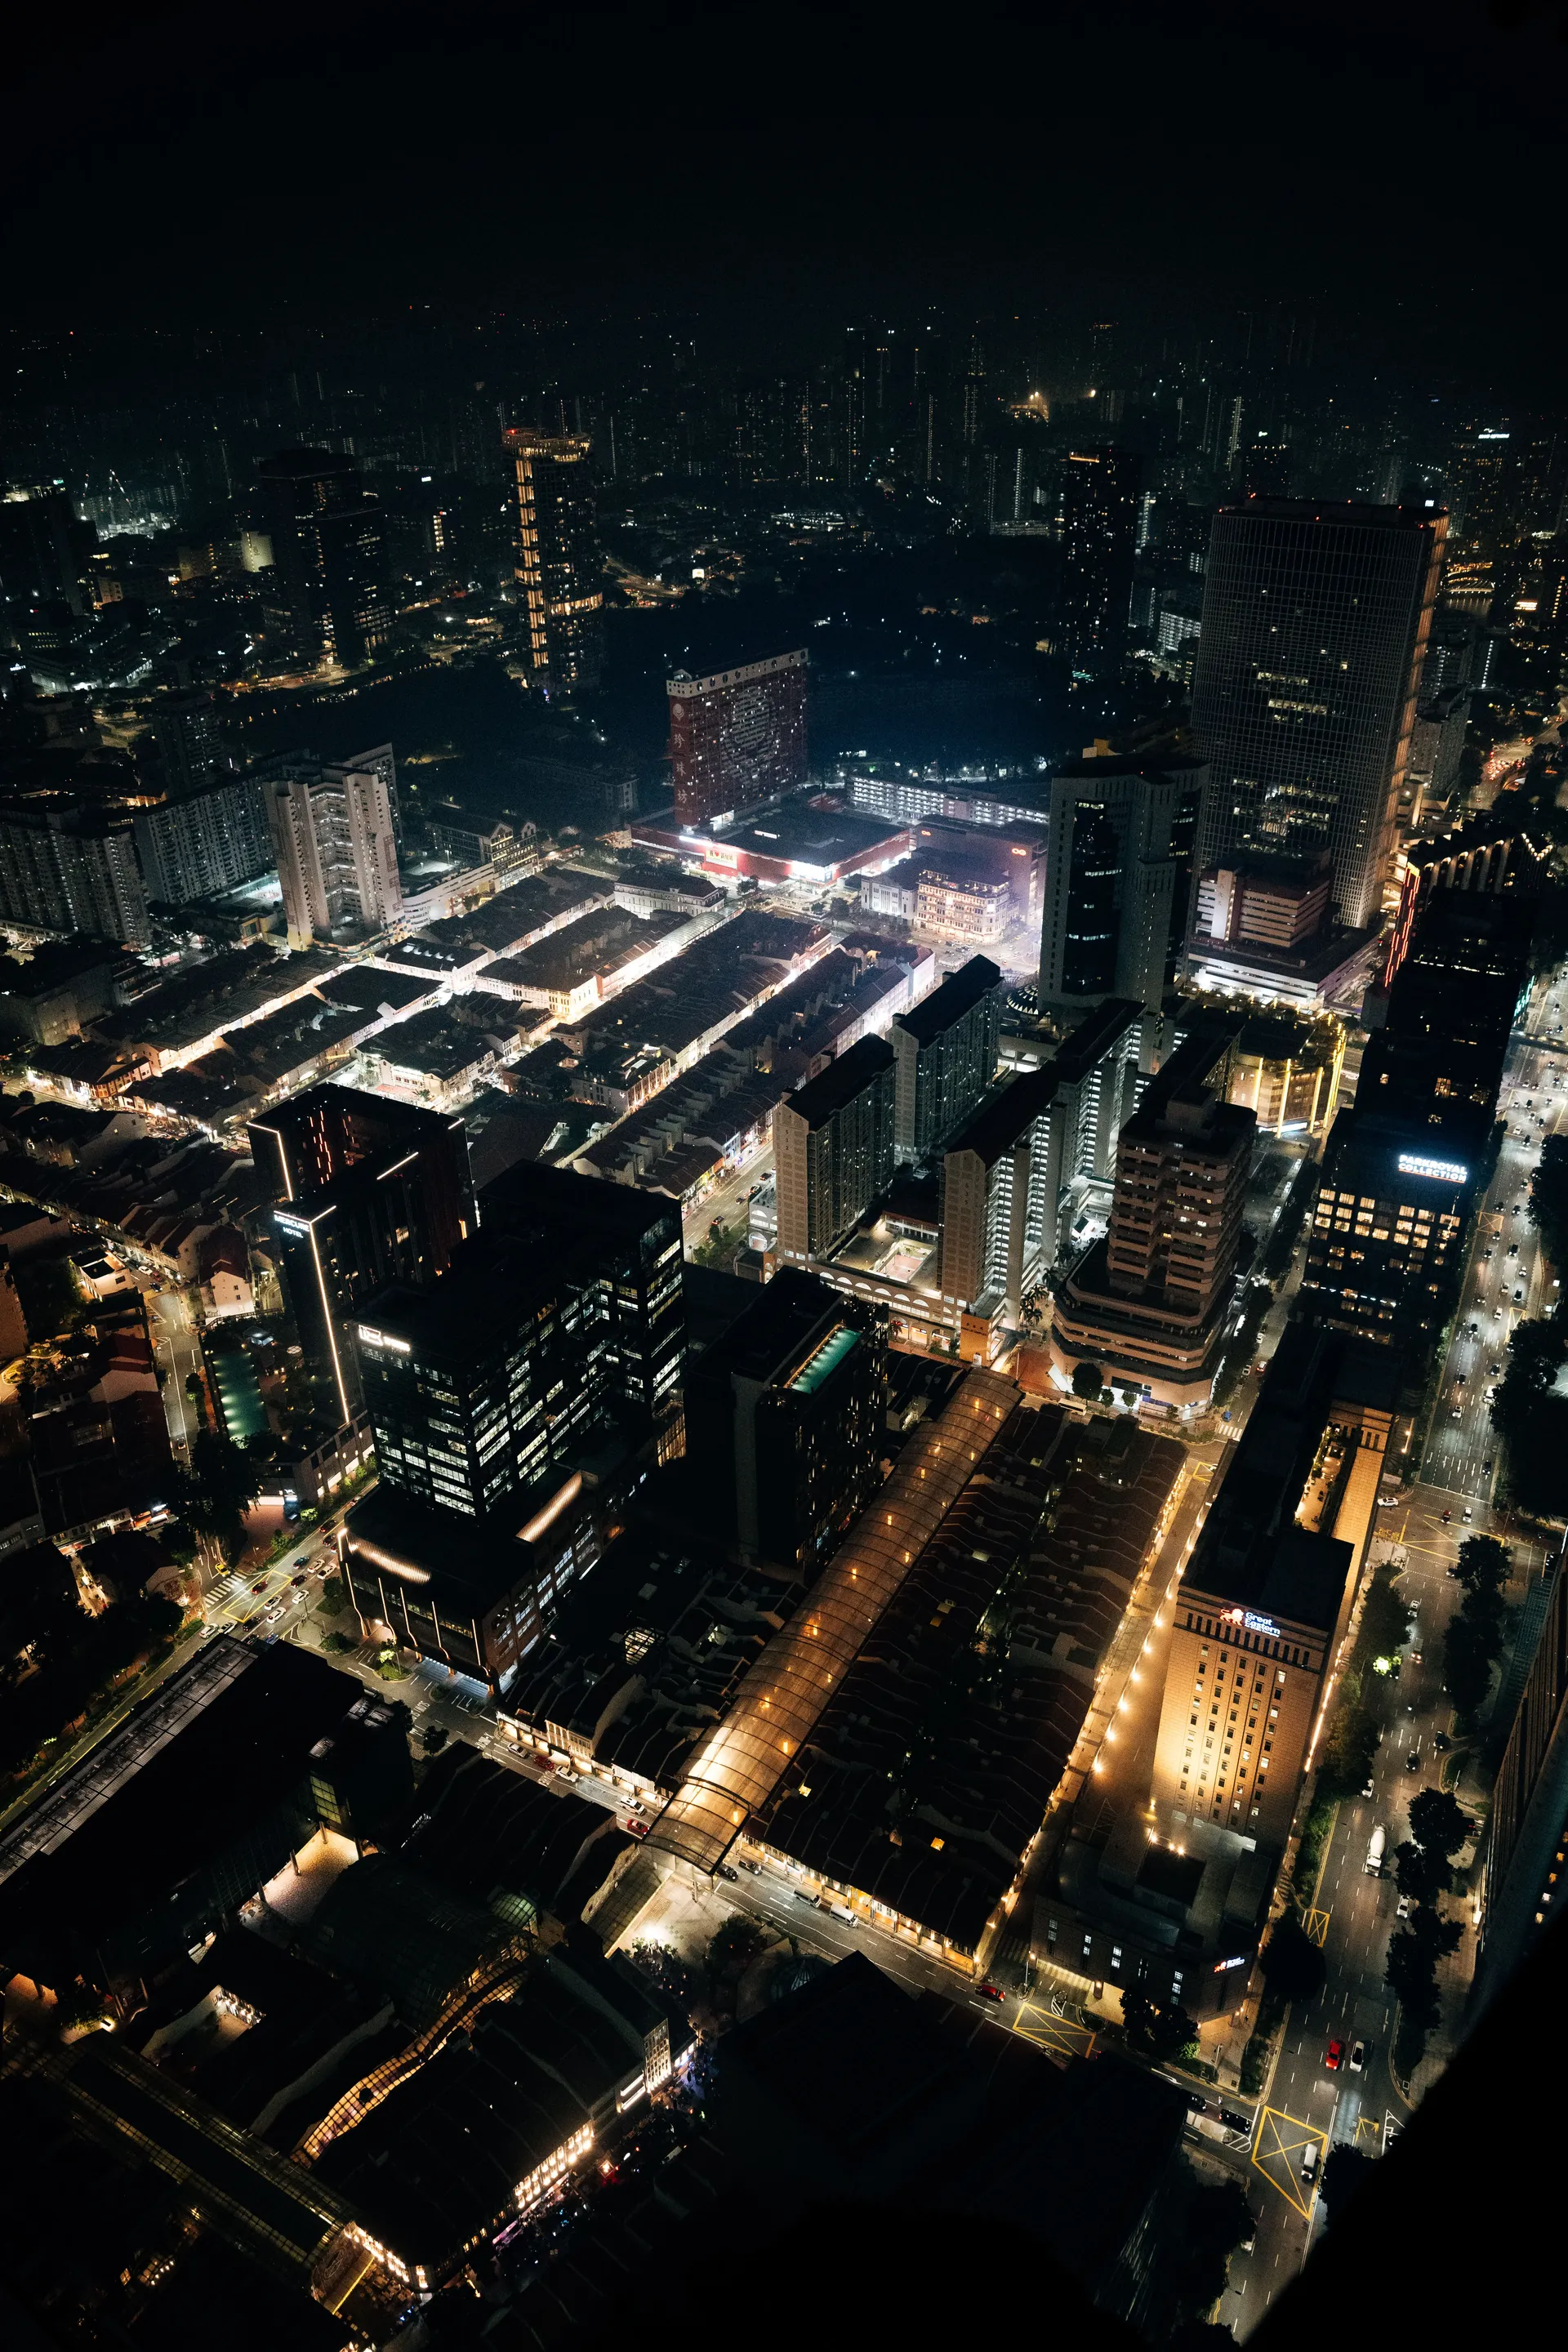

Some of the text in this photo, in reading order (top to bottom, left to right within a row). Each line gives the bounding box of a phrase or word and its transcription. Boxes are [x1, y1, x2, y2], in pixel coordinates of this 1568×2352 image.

[674, 733, 688, 804] 珍珠坊
[1398, 1162, 1467, 1181] COLLECTION
[1399, 1155, 1468, 1174] PARKROYAL
[274, 1214, 310, 1232] MERCURE
[283, 1227, 304, 1238] HOTEL
[1245, 1612, 1272, 1626] Great
[1245, 1618, 1281, 1634] Eastern
